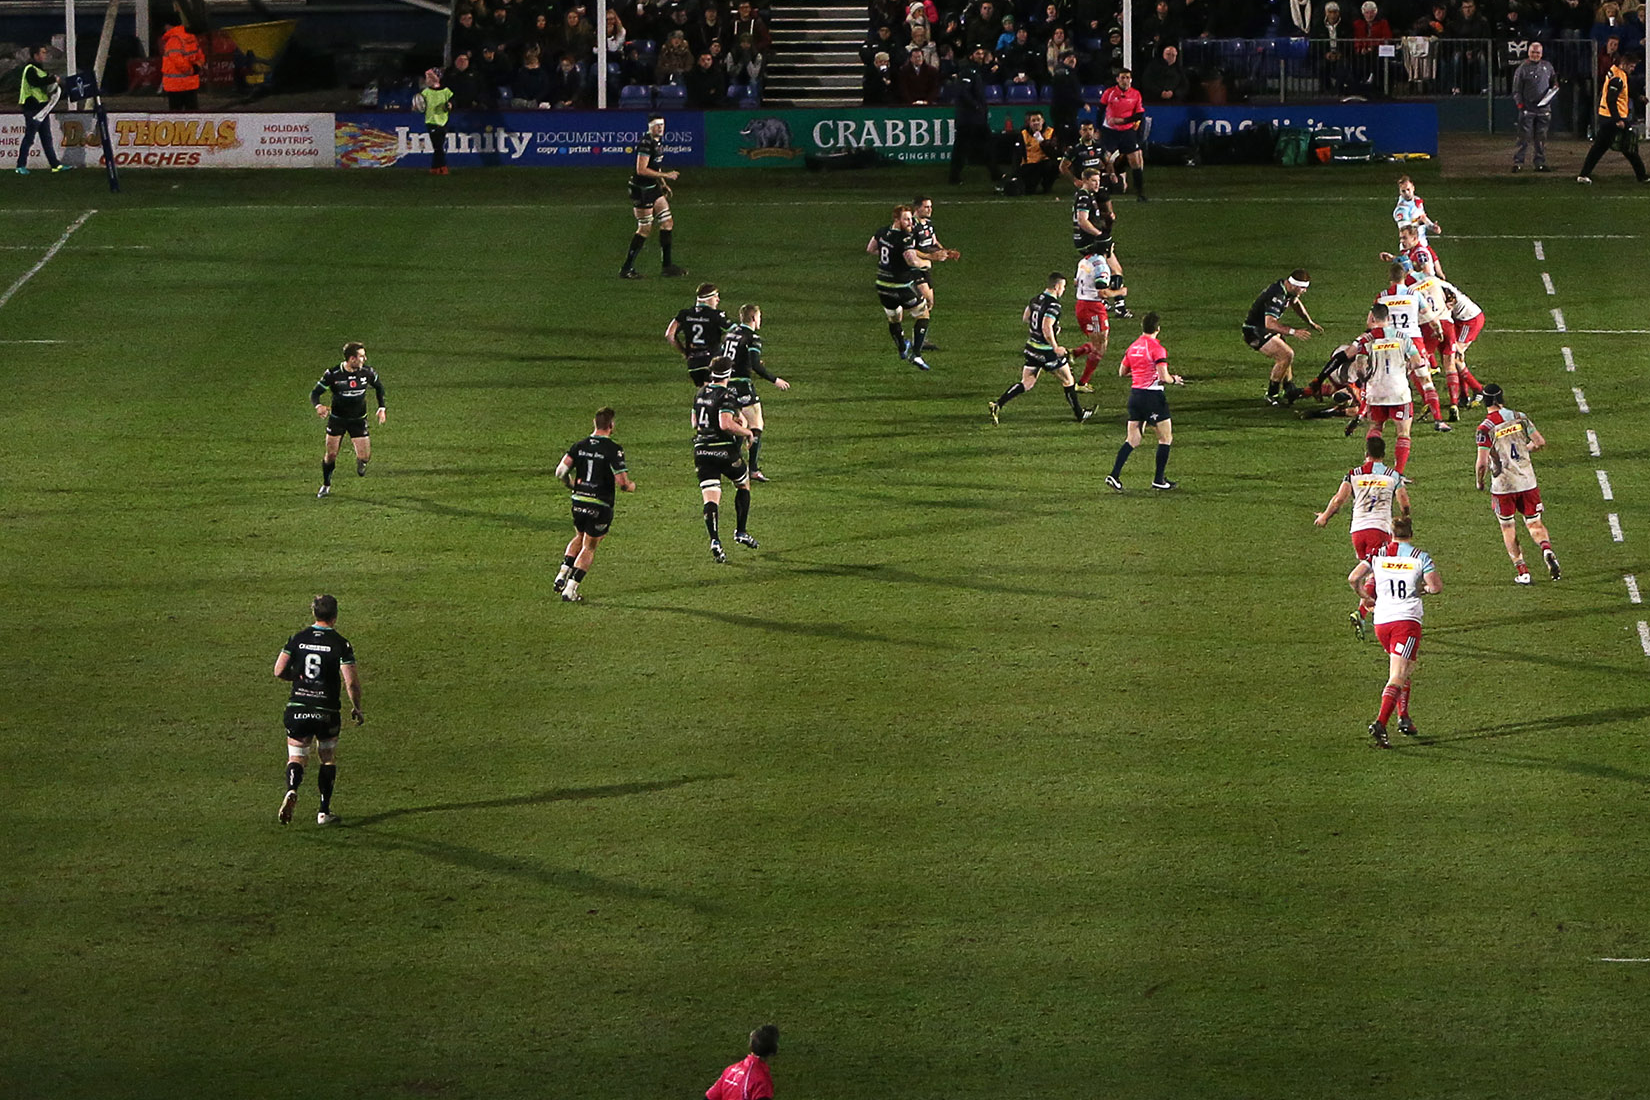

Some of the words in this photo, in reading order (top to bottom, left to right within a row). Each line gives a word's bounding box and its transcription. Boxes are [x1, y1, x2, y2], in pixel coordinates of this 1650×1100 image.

[115, 119, 238, 148] THOMAS
[263, 124, 310, 133] HOLIDAYS
[537, 131, 615, 143] DOCUMENT
[615, 131, 693, 143] SOLIONS
[260, 136, 267, 145] &
[269, 136, 314, 145] DAYTRIPS
[395, 125, 533, 159] Ininity
[255, 148, 283, 157] 01639
[285, 148, 319, 157] 636640
[536, 147, 559, 155] copy
[569, 146, 591, 154] print
[898, 152, 937, 160] GINGER
[881, 246, 890, 264] 8
[1427, 296, 1438, 312] 2
[1391, 313, 1410, 328] 12
[692, 324, 705, 344] 2
[723, 340, 739, 361] 15
[698, 407, 710, 428] 4
[1510, 443, 1520, 460] 4
[586, 459, 594, 482] 1
[1390, 579, 1407, 599] 18
[305, 653, 322, 679] 6
